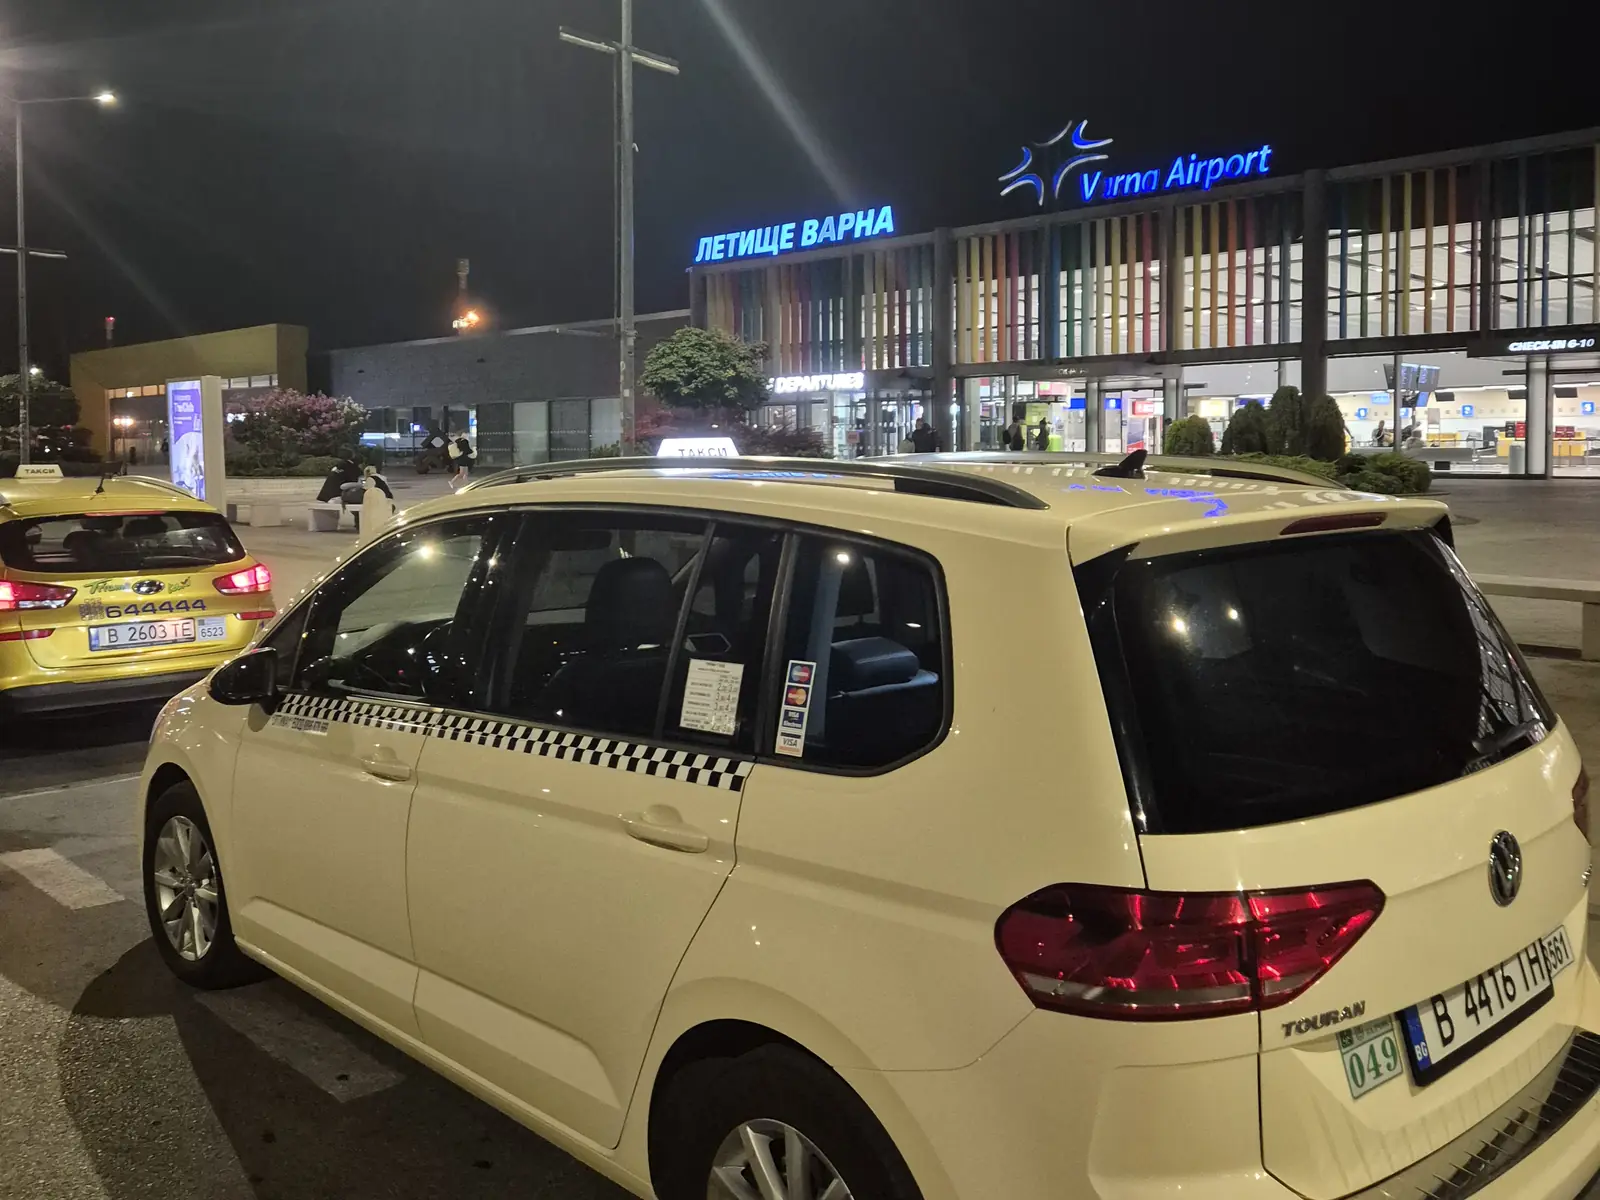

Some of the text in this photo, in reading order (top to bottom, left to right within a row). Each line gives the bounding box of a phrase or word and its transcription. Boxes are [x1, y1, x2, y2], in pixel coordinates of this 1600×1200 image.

[1164, 144, 1273, 191] Airport
[695, 205, 894, 262] ЛЕТИЩЕ ВАРНА
[1508, 339, 1595, 352] CHECK-IN 6-10
[677, 447, 728, 457] ТАКСИ
[105, 599, 207, 619] 644444
[107, 621, 193, 644] B 2603 TE
[200, 626, 225, 638] 6523
[783, 738, 798, 747] VISA
[1430, 993, 1455, 1048] B
[1464, 961, 1516, 1025] 4416
[1282, 1000, 1366, 1038] TOURAN
[1414, 1041, 1429, 1061] BG
[1349, 1036, 1398, 1088] 049
